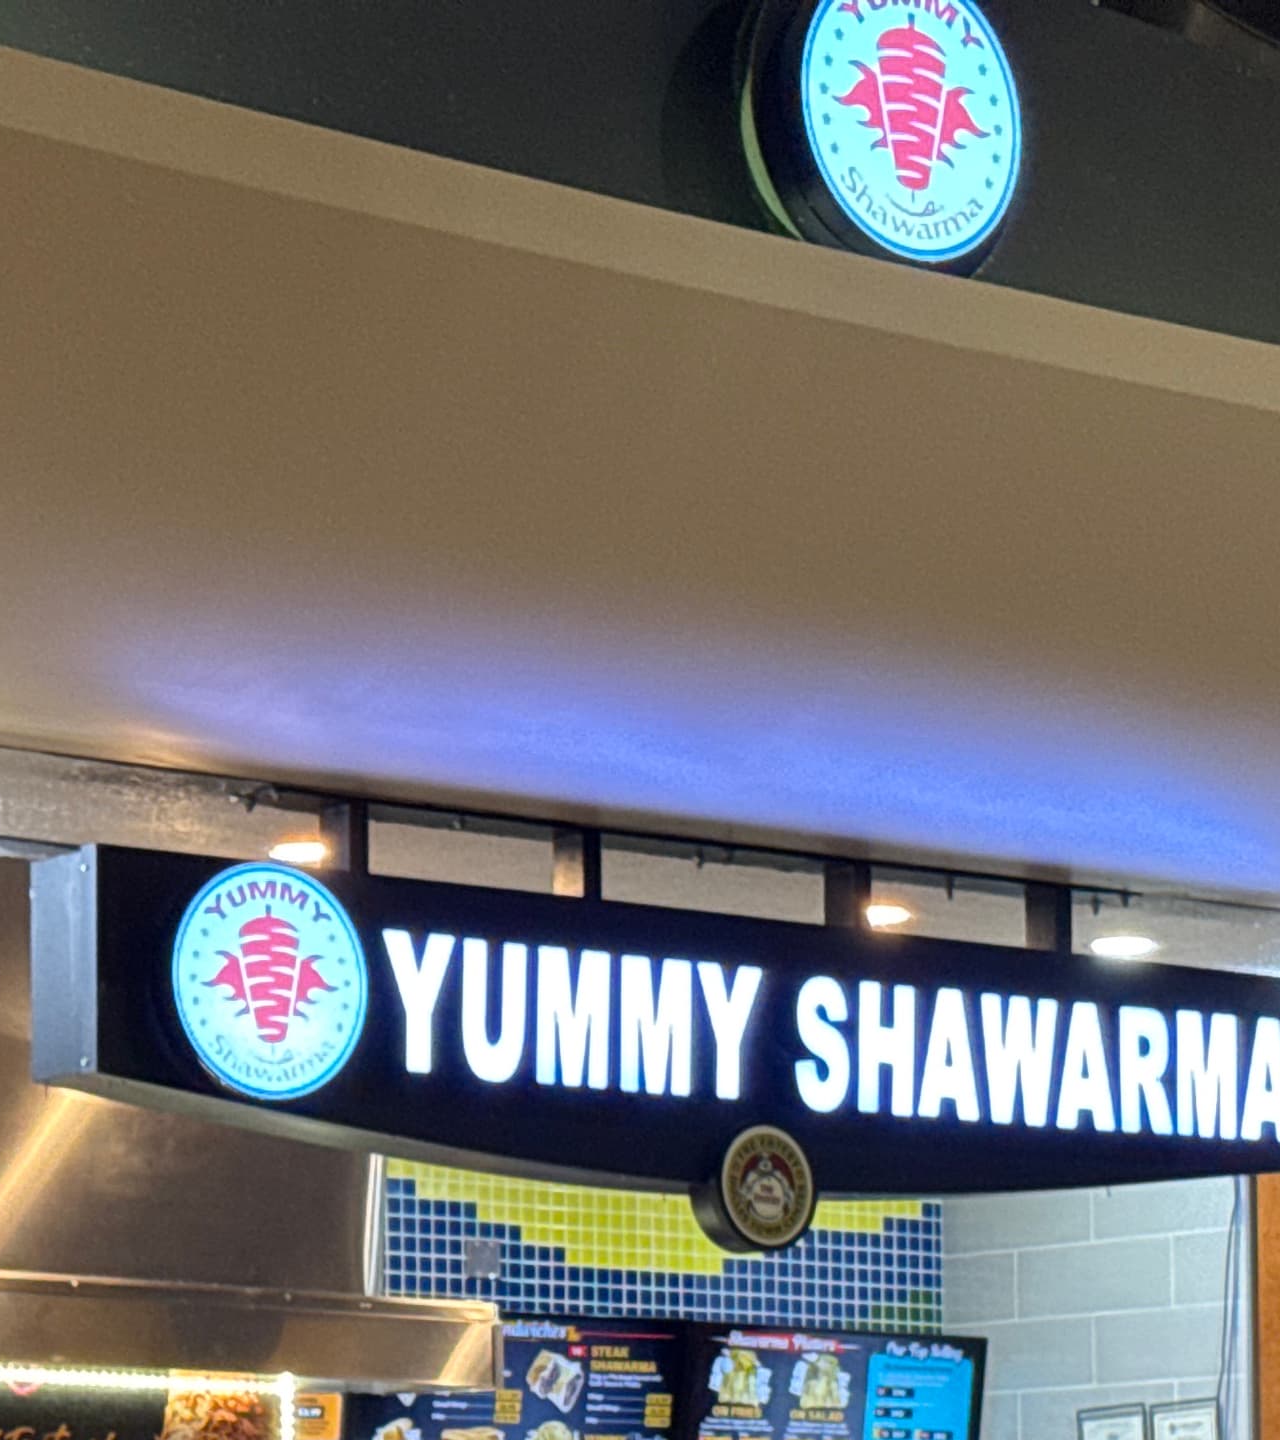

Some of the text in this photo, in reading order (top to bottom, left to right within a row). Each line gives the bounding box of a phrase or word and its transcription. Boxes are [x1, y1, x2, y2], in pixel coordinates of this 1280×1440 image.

[840, 166, 984, 240] Shawarma
[204, 880, 333, 923] YUMMY
[382, 928, 763, 1100] YUMMY
